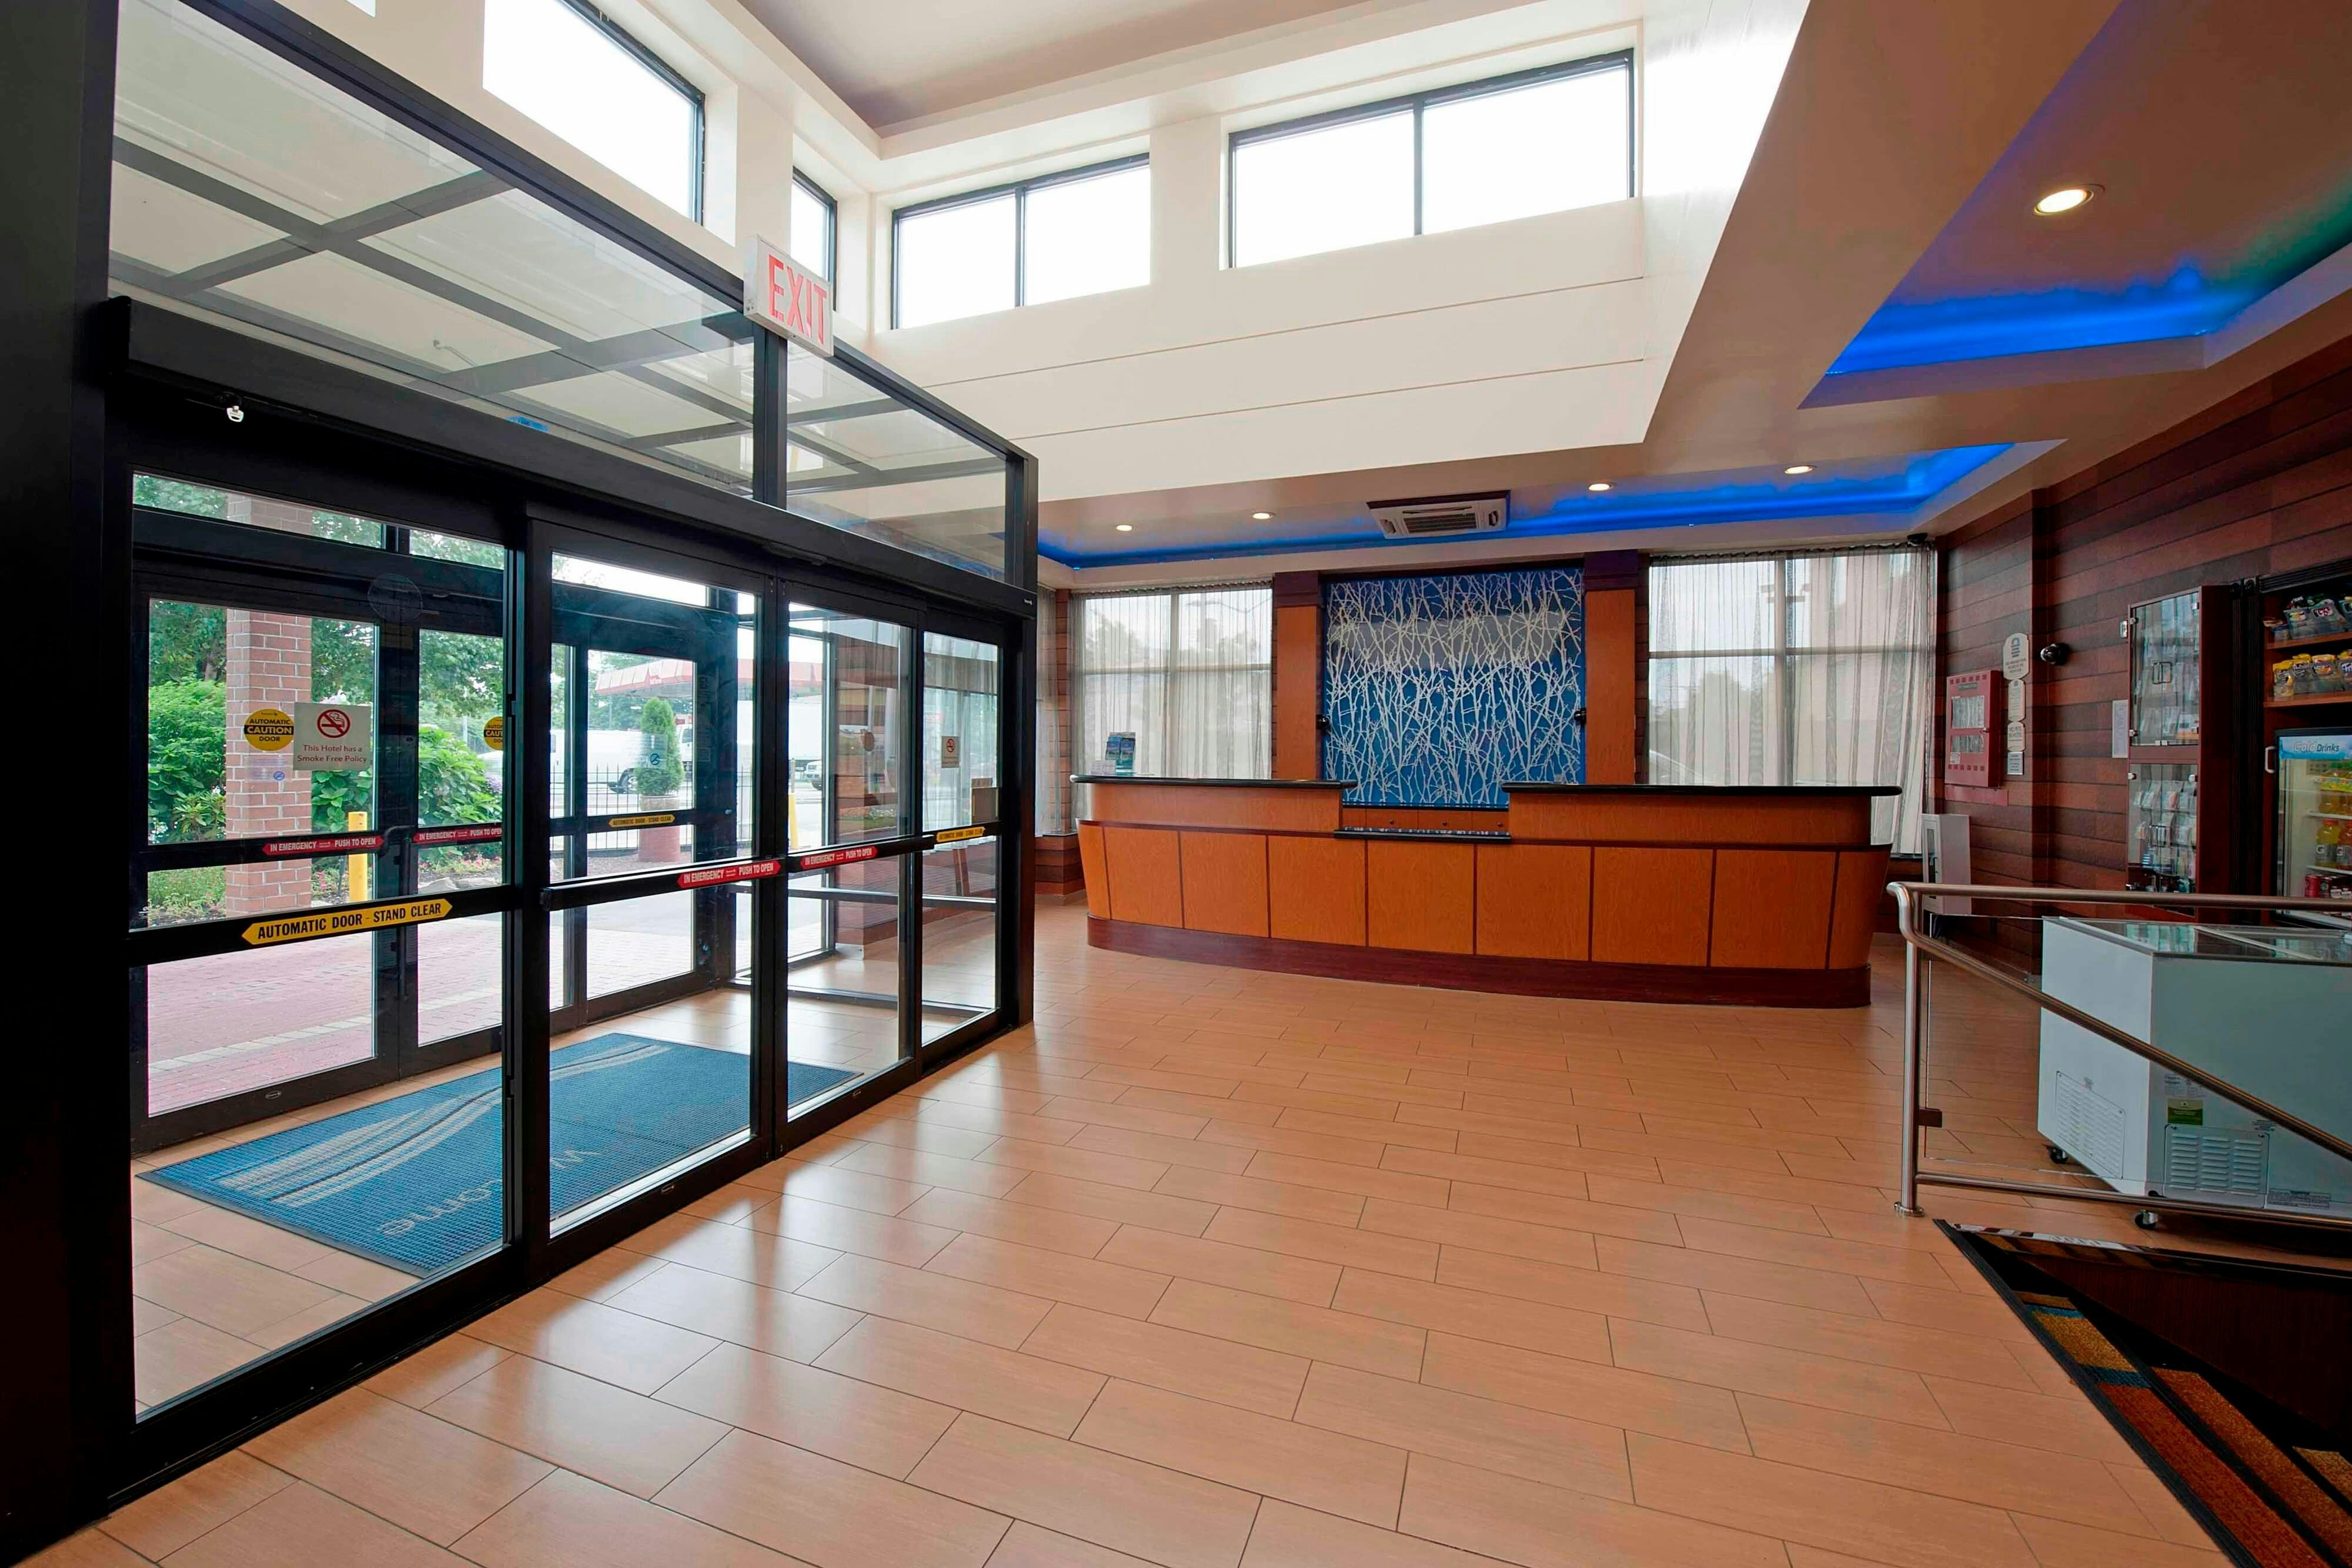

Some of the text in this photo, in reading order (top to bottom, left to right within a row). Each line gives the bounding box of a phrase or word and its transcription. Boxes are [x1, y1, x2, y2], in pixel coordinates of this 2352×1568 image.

[768, 253, 827, 345] EXIT
[247, 726, 292, 734] CAUTION
[2294, 741, 2340, 753] Cold Drinks
[426, 831, 456, 840] EMERGENCY
[279, 841, 317, 851] EMERGENCY
[335, 839, 350, 847] PUSH
[360, 837, 376, 845] OPEN
[684, 874, 690, 883] IN
[691, 870, 724, 882] EMERGENCY
[739, 865, 752, 875] PUSH
[753, 864, 760, 873] TO
[761, 862, 773, 872] OPEN
[258, 918, 327, 939] AUTOMATIC
[332, 913, 362, 928] DOOR
[373, 907, 406, 922] STAND
[411, 902, 441, 917] CLEAR
